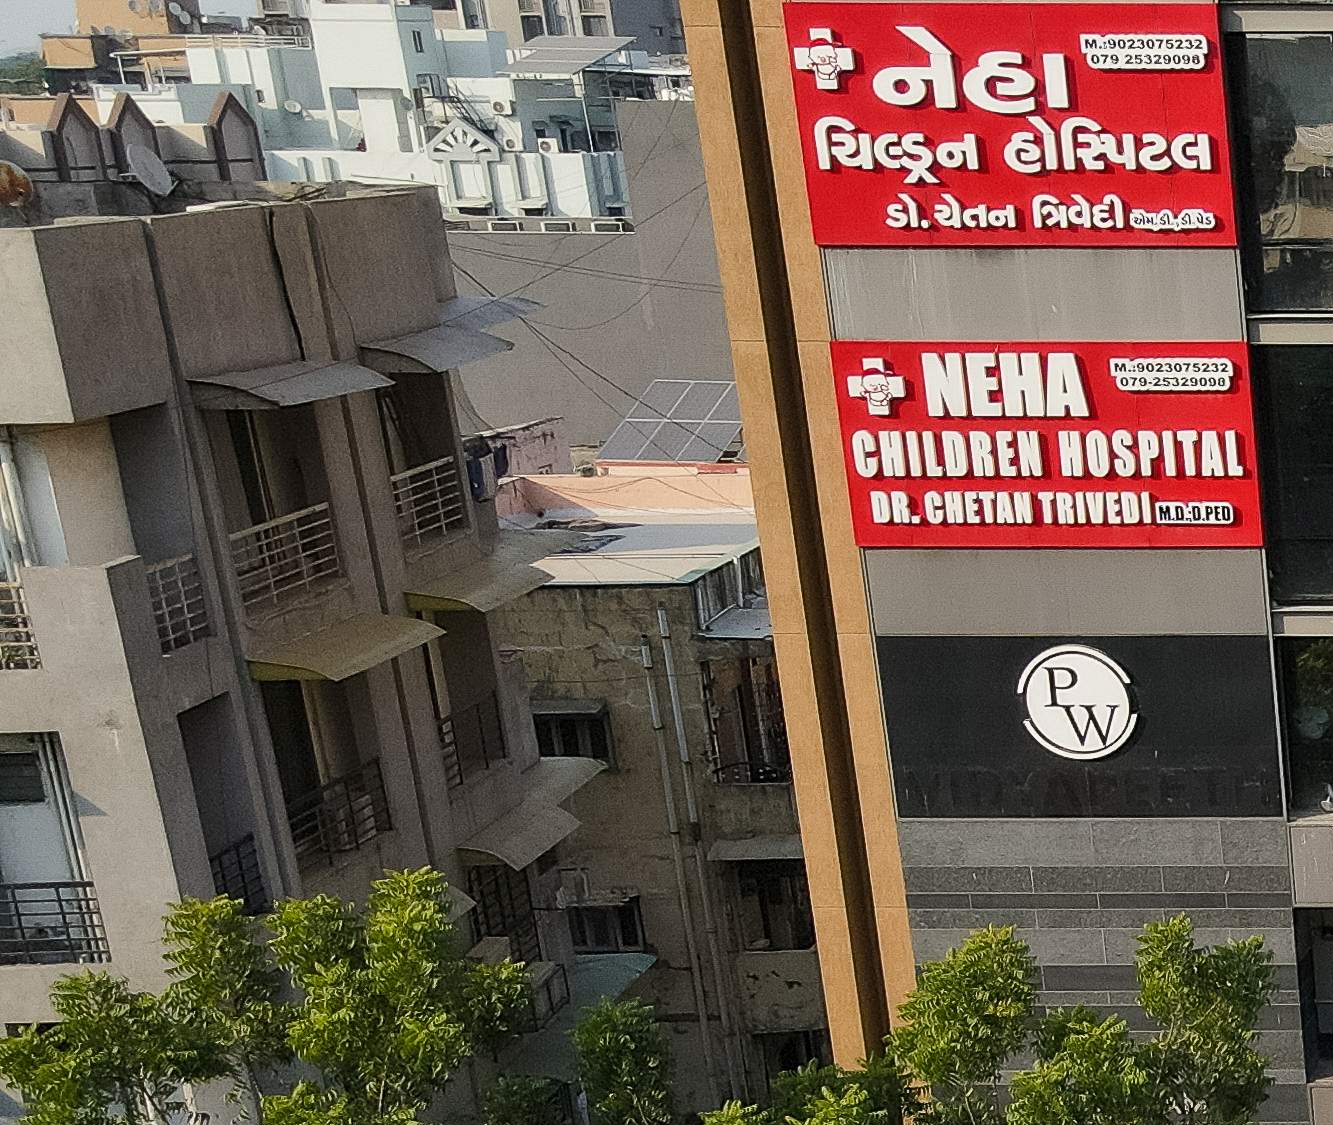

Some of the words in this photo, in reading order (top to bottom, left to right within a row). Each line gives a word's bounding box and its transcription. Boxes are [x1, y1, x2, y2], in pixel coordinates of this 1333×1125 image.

[871, 25, 1070, 115] નેહા
[1091, 54, 1119, 64] 079
[1125, 54, 1200, 64] 25329098
[1003, 116, 1212, 174] હોસ્પિટલ
[934, 194, 1017, 229] ચેતન
[1032, 194, 1124, 230] ત્રિવેદી
[921, 352, 1090, 418] NEHA
[1120, 377, 1226, 387] 079-25329098
[852, 429, 1043, 478] CHILDREN
[1059, 429, 1244, 477] HOSPITAL
[870, 491, 921, 524] DR.
[927, 491, 1034, 524] CHETAN
[1038, 491, 1152, 524] TRIVEDI
